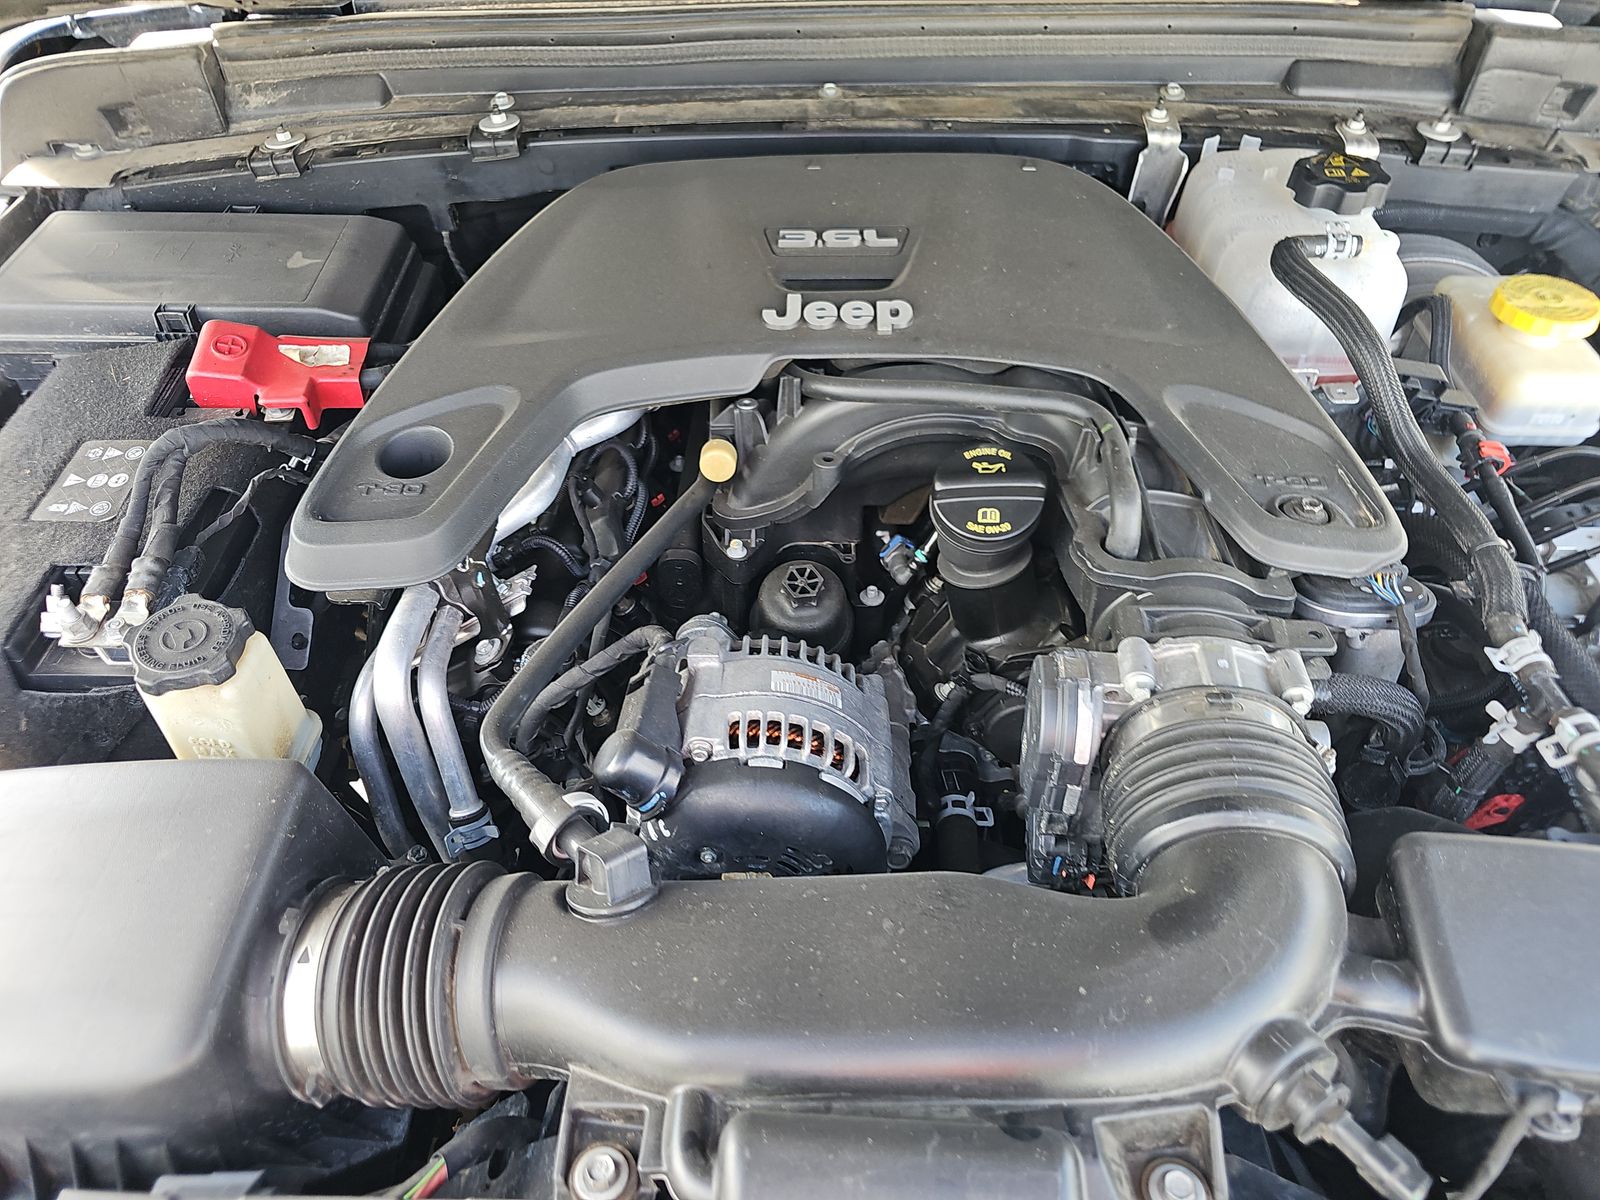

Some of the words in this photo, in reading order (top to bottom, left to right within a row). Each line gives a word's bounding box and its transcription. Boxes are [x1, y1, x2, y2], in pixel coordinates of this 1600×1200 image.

[778, 229, 898, 248] 3.6L
[762, 293, 914, 335] Jeep
[963, 447, 997, 460] ENGINE
[998, 449, 1012, 460] OIL
[966, 521, 985, 534] SAE
[137, 634, 166, 669] STEERING
